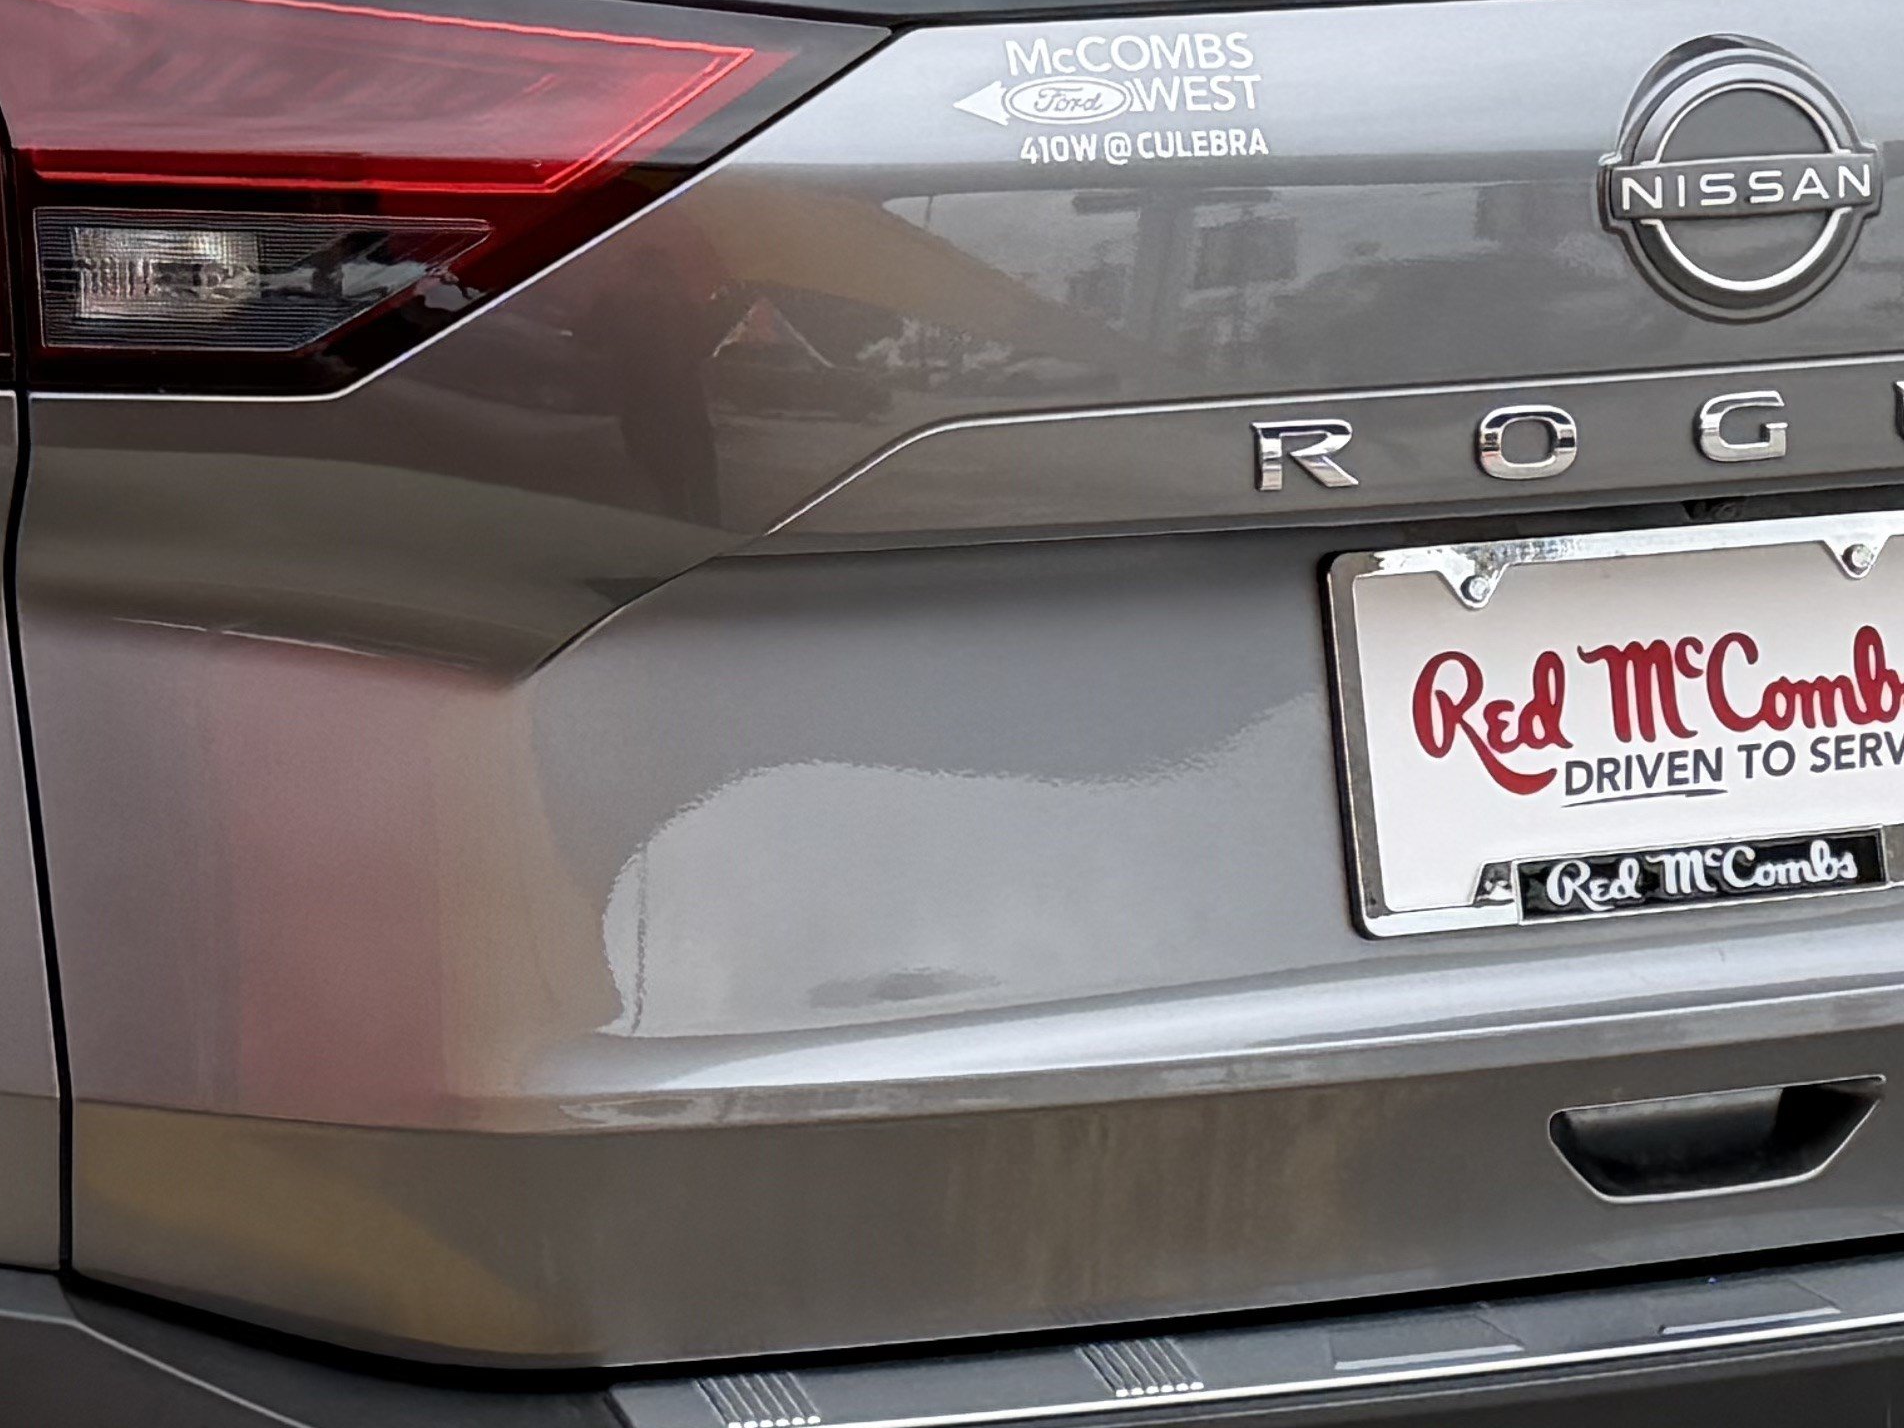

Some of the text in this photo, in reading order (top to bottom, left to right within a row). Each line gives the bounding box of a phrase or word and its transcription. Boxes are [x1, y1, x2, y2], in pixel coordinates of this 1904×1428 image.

[1005, 31, 1254, 76] McCOMBS
[1033, 74, 1263, 113] Ford WEST
[1020, 128, 1270, 165] 410W @ CULEBRA
[1620, 164, 1871, 210] NISSAN
[1412, 650, 1573, 796] Red
[1564, 745, 1724, 796] DRIVEN
[1737, 739, 1796, 779] TO
[1546, 859, 1644, 911] Red
